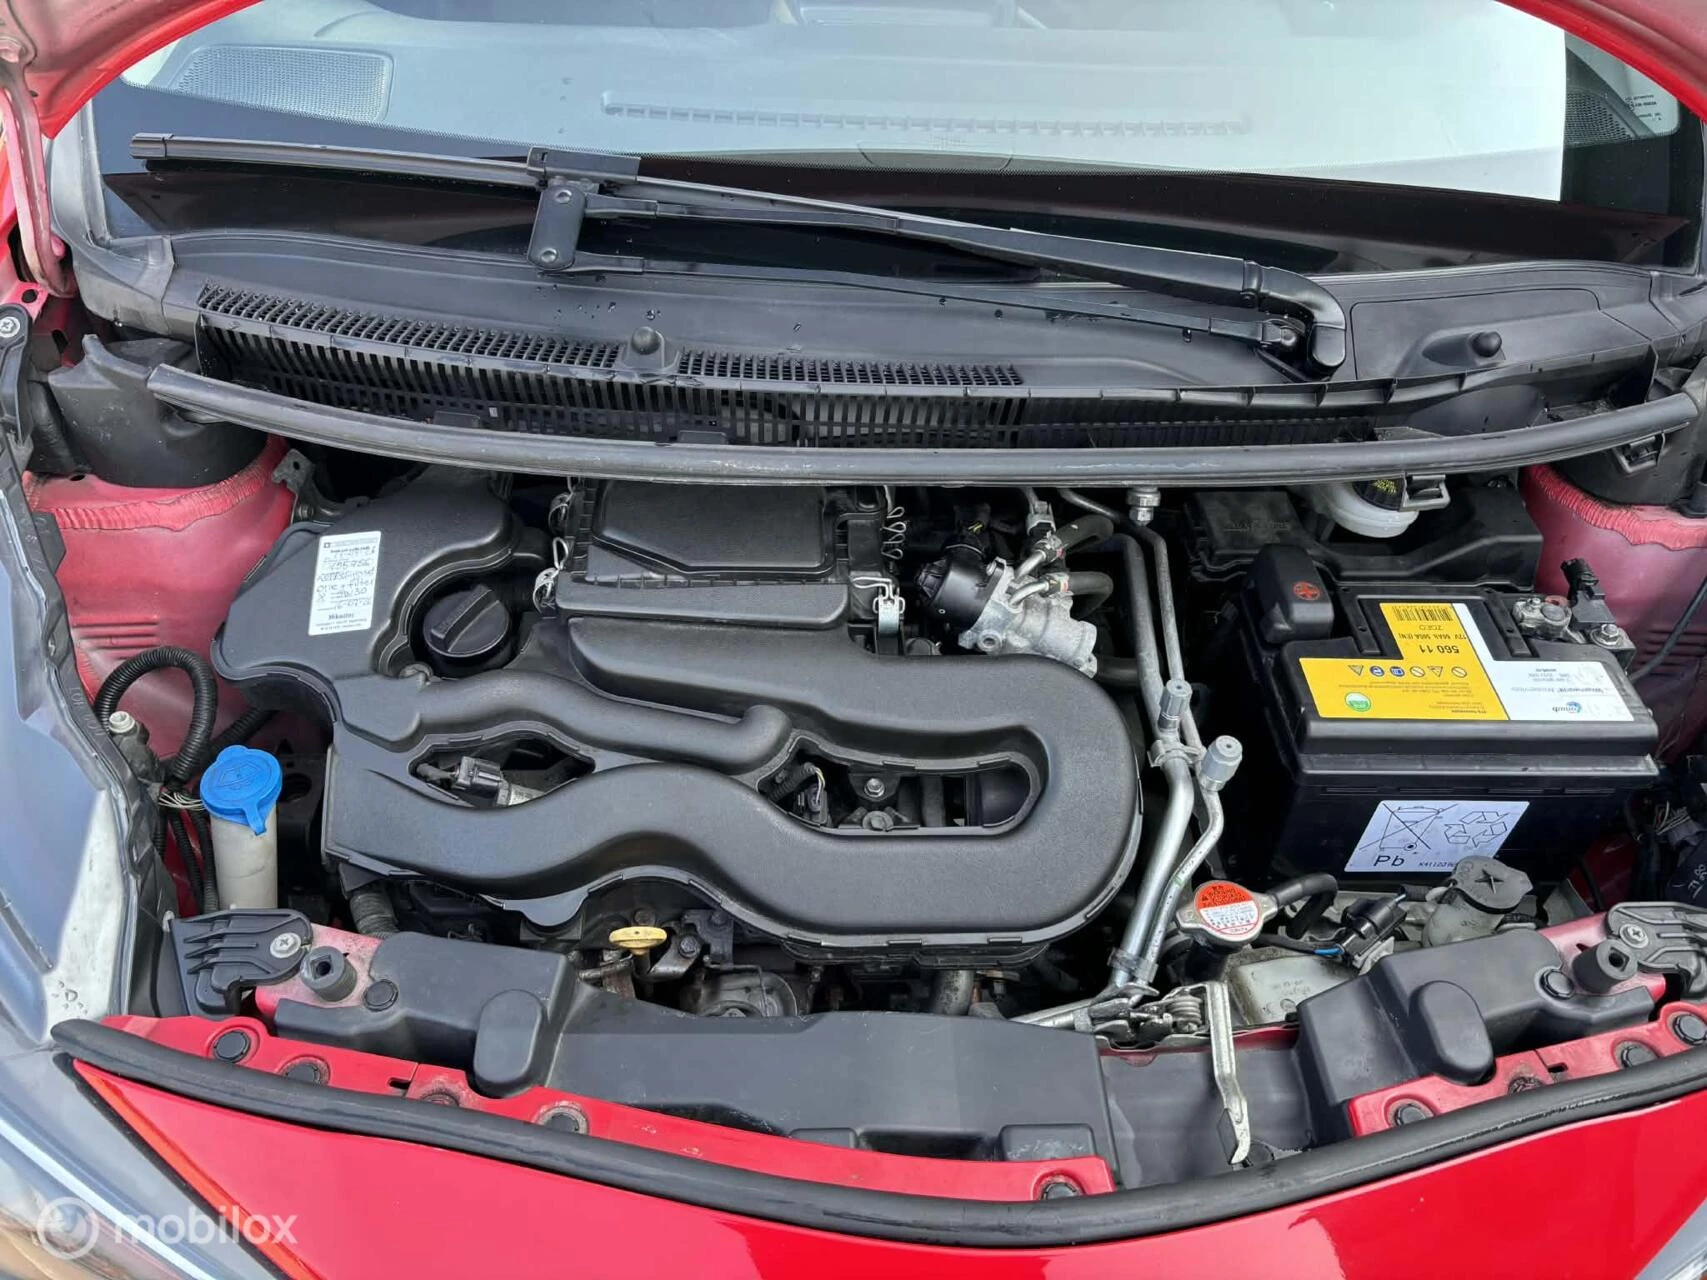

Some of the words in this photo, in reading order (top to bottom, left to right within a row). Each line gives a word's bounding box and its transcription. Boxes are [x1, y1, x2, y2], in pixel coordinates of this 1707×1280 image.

[1419, 645, 1433, 653] 11
[1437, 645, 1460, 654] 560
[1373, 855, 1405, 867] Pb
